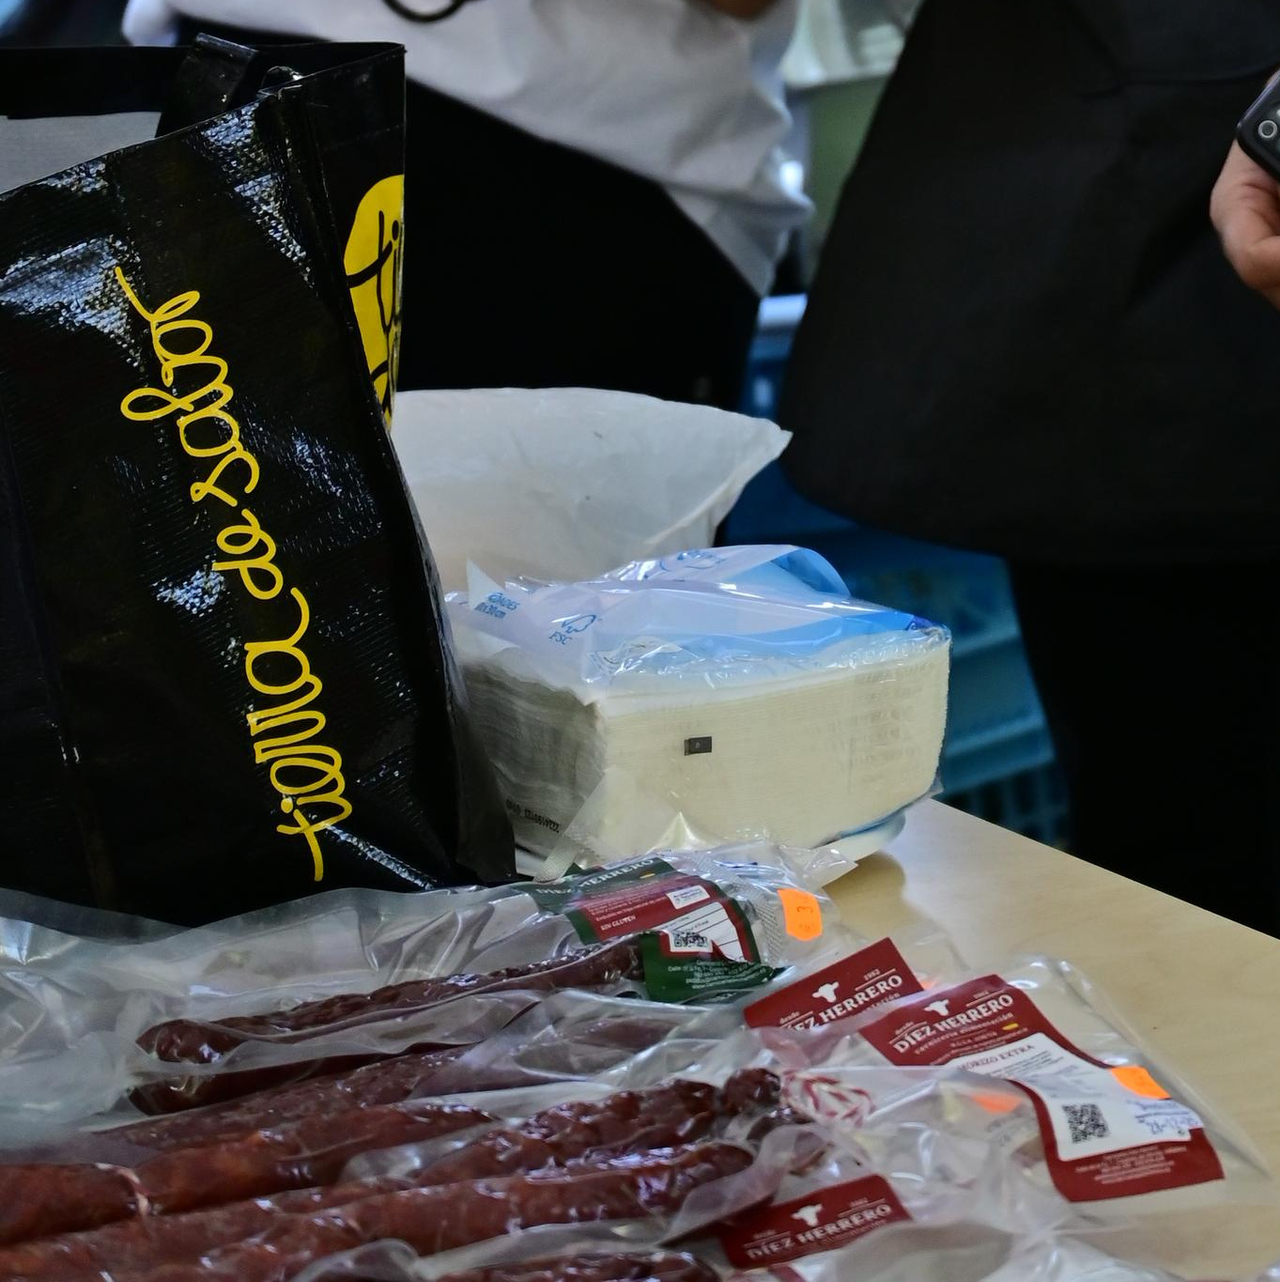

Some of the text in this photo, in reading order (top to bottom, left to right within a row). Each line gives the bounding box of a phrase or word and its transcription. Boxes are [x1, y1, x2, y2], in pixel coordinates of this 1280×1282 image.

[114, 265, 353, 882] tierra de sabor
[548, 631, 573, 646] FSC
[818, 974, 903, 1023] HERRERO
[933, 993, 1014, 1033] HERRERO
[795, 1203, 893, 1245] HERRERO
